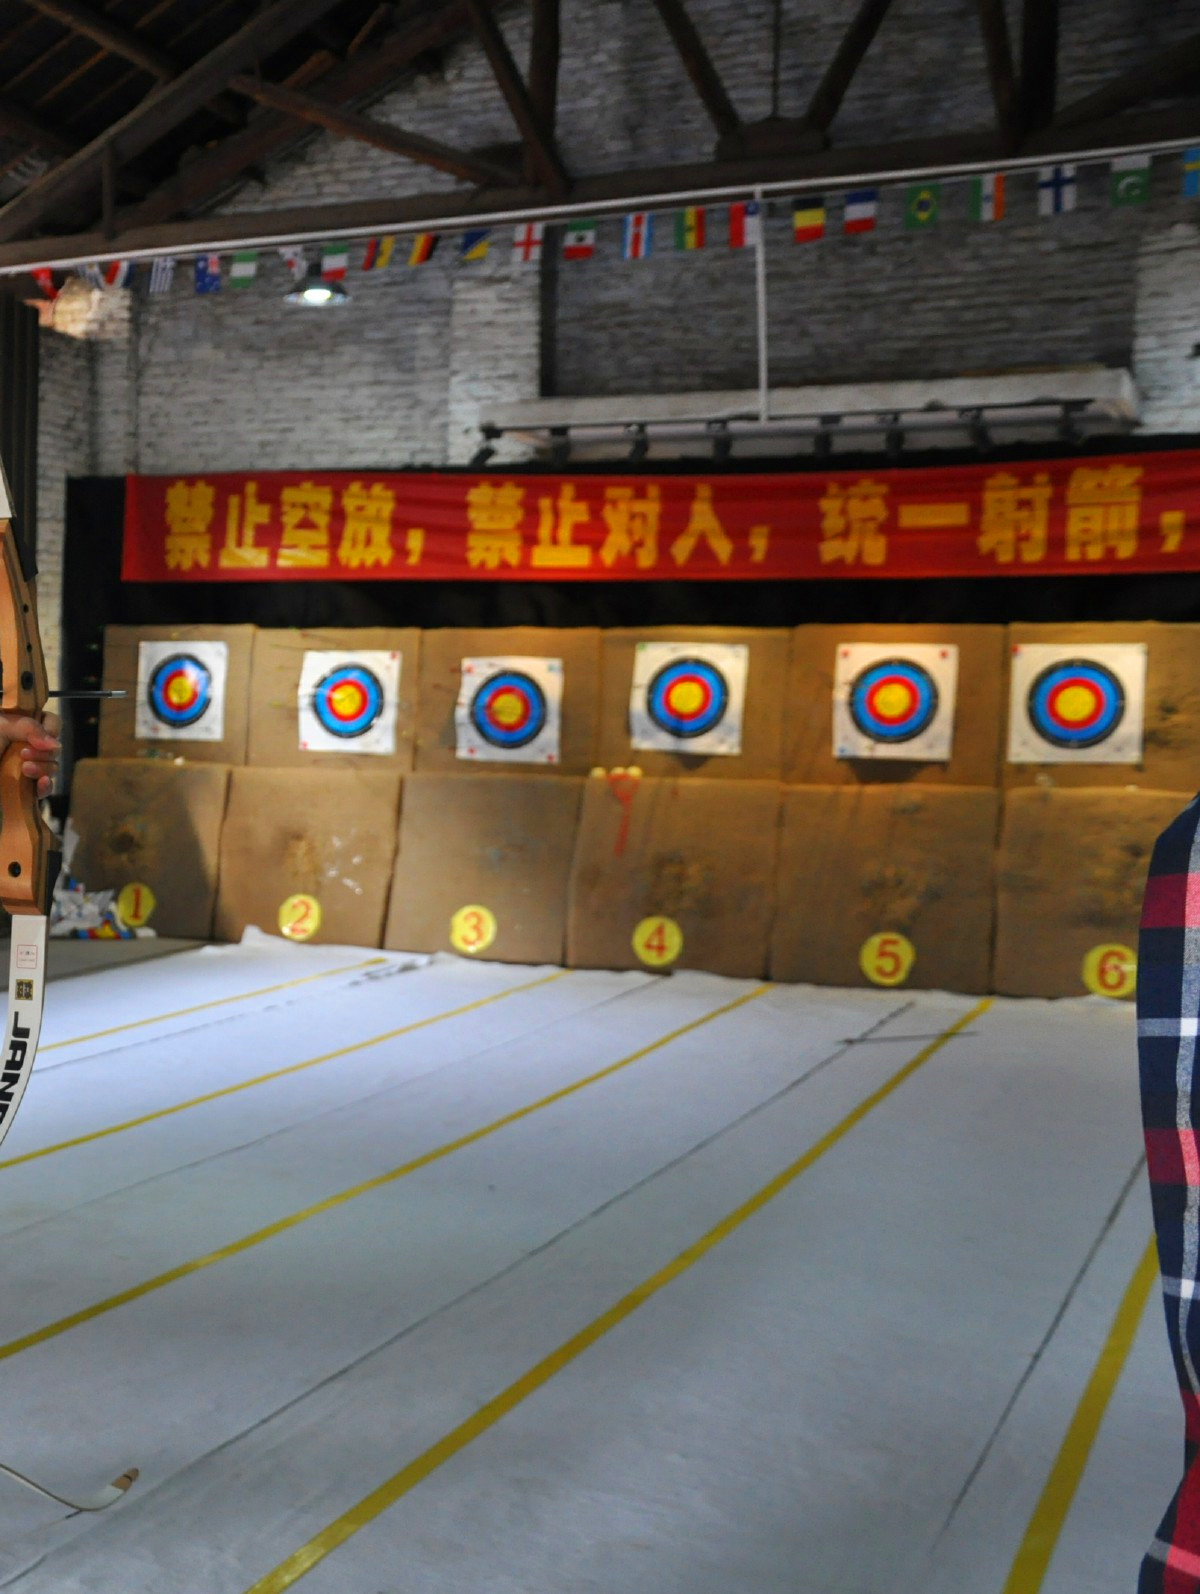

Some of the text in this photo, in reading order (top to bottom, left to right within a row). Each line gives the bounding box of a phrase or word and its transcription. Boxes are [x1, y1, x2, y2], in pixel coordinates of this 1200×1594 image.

[130, 886, 142, 920] 1
[291, 899, 311, 934] 2
[461, 911, 483, 945] 3
[644, 923, 669, 959] 4
[875, 938, 902, 978] 5
[1097, 949, 1127, 991] 6
